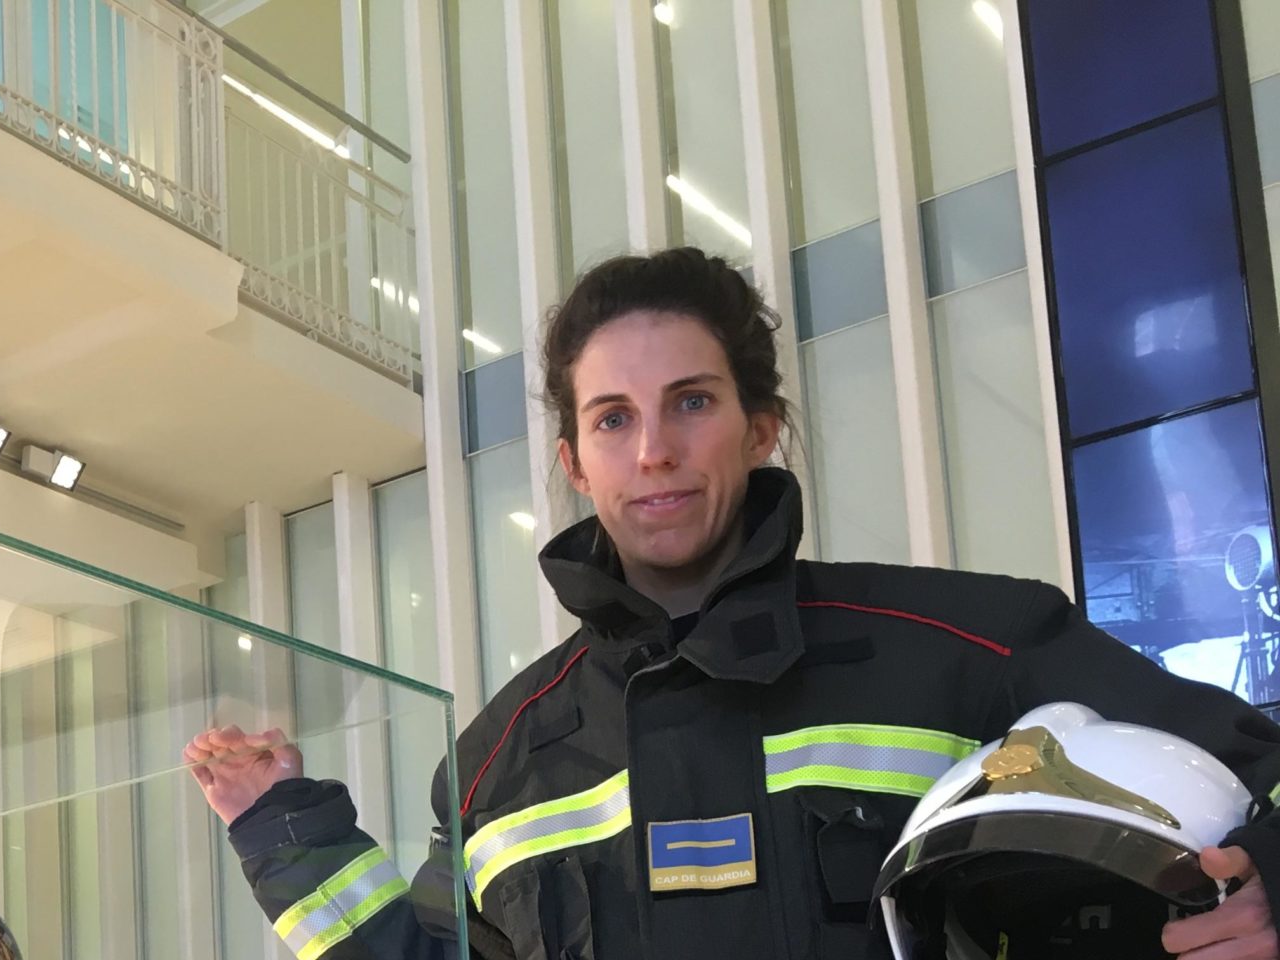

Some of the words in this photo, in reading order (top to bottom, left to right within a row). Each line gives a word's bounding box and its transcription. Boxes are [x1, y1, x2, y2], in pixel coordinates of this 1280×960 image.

[655, 875, 679, 885] CAP
[681, 874, 697, 883] DE
[700, 870, 751, 883] GUARDIA
